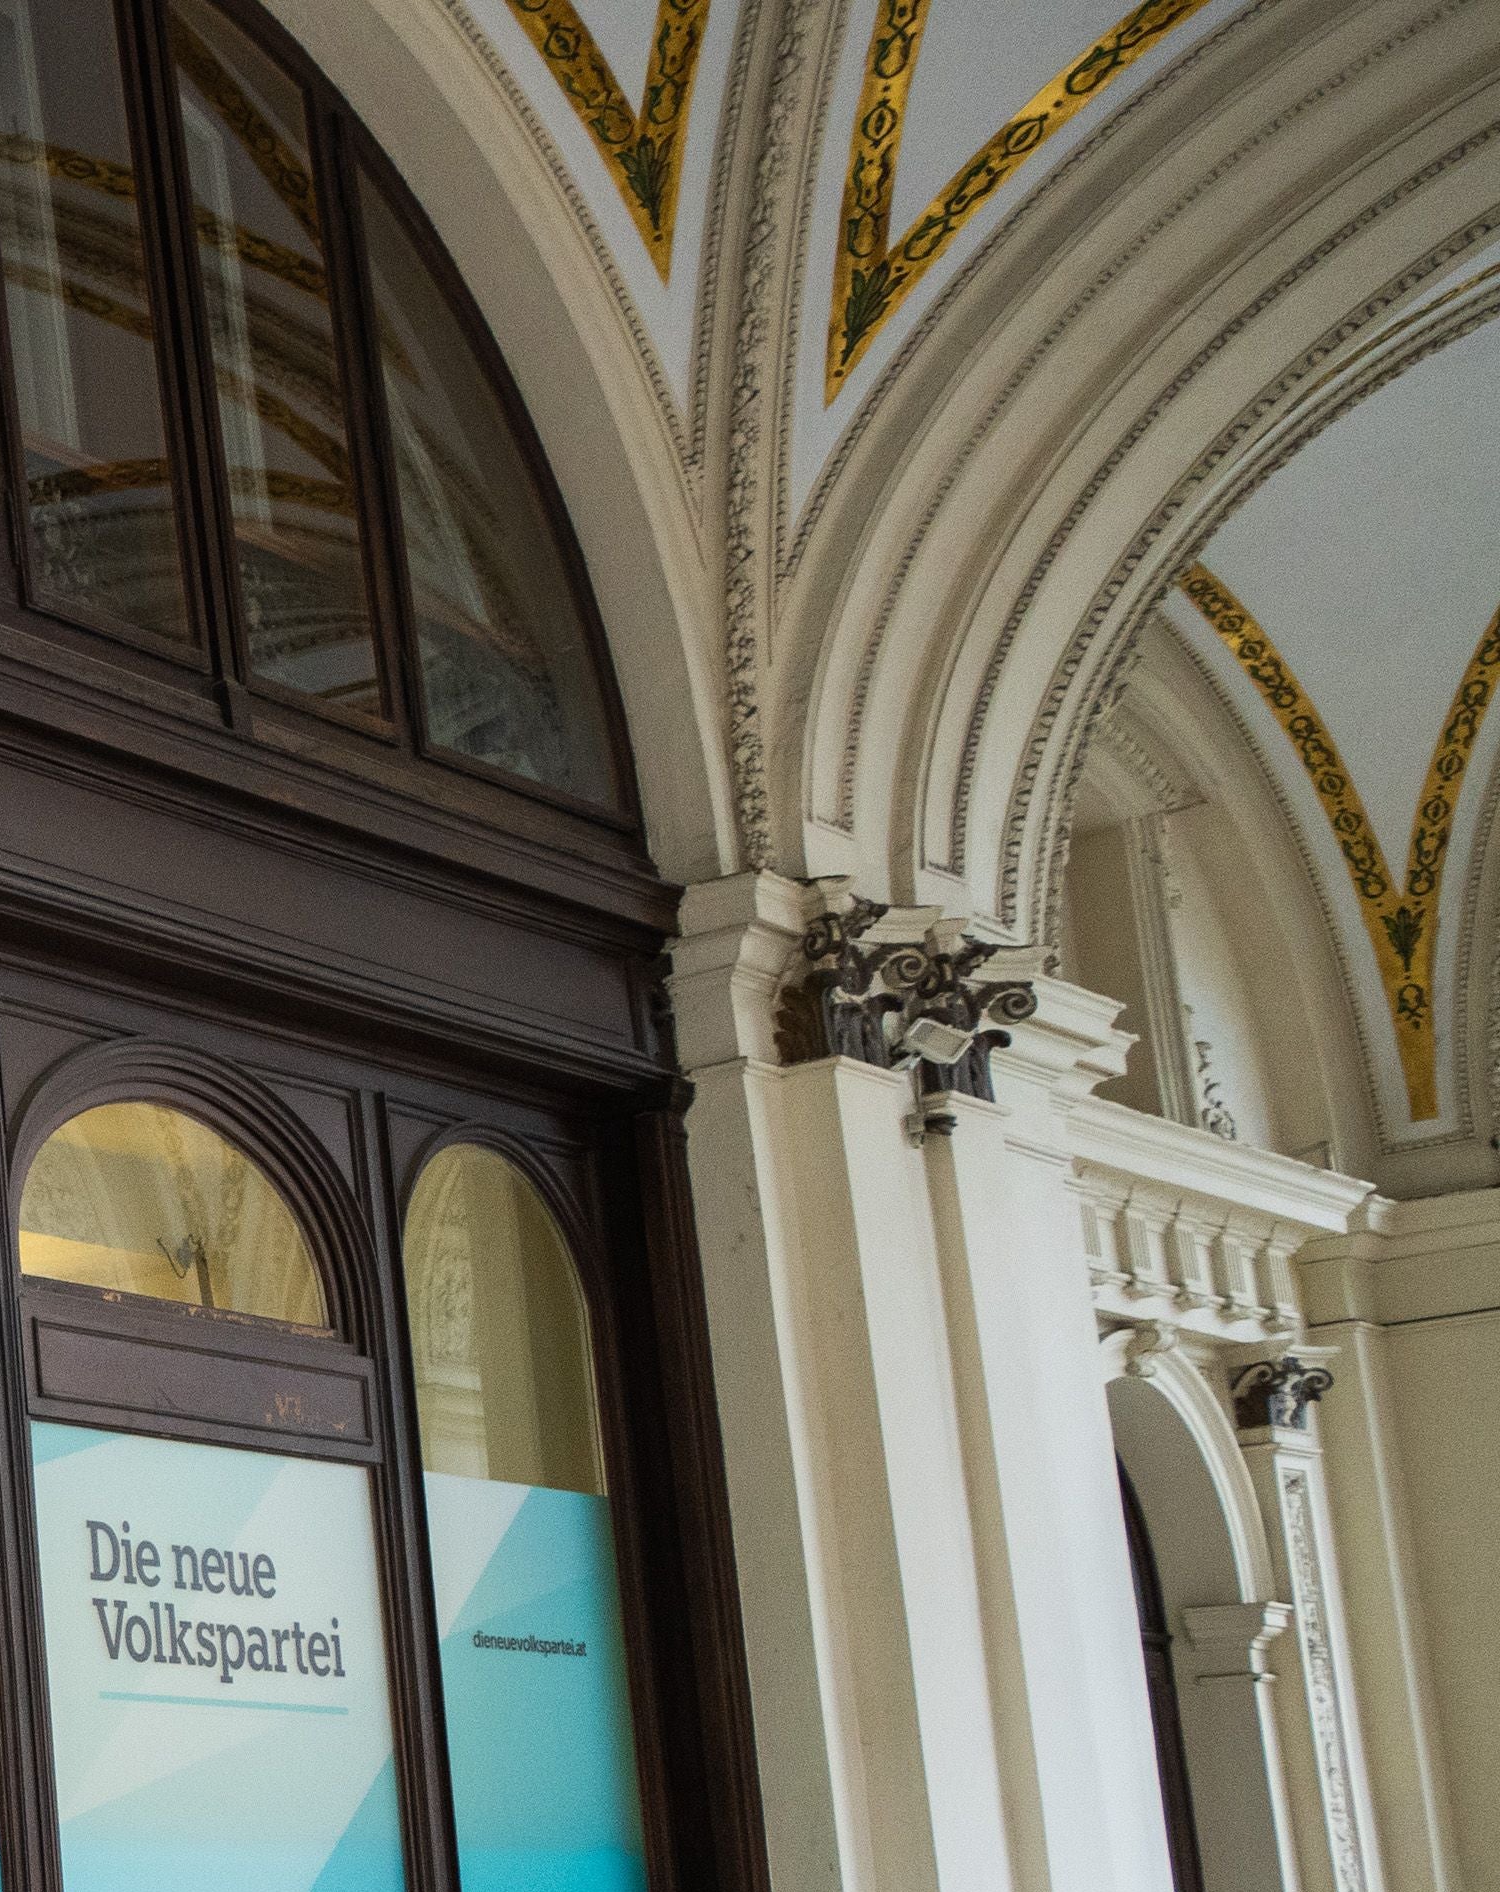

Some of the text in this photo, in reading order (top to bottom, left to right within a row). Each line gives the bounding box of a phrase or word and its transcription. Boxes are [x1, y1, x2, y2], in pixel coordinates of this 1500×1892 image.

[86, 1519, 277, 1599] Die neue
[92, 1598, 346, 1684] Volkspartei
[472, 1630, 587, 1658] dieneuevolkspartei.at
